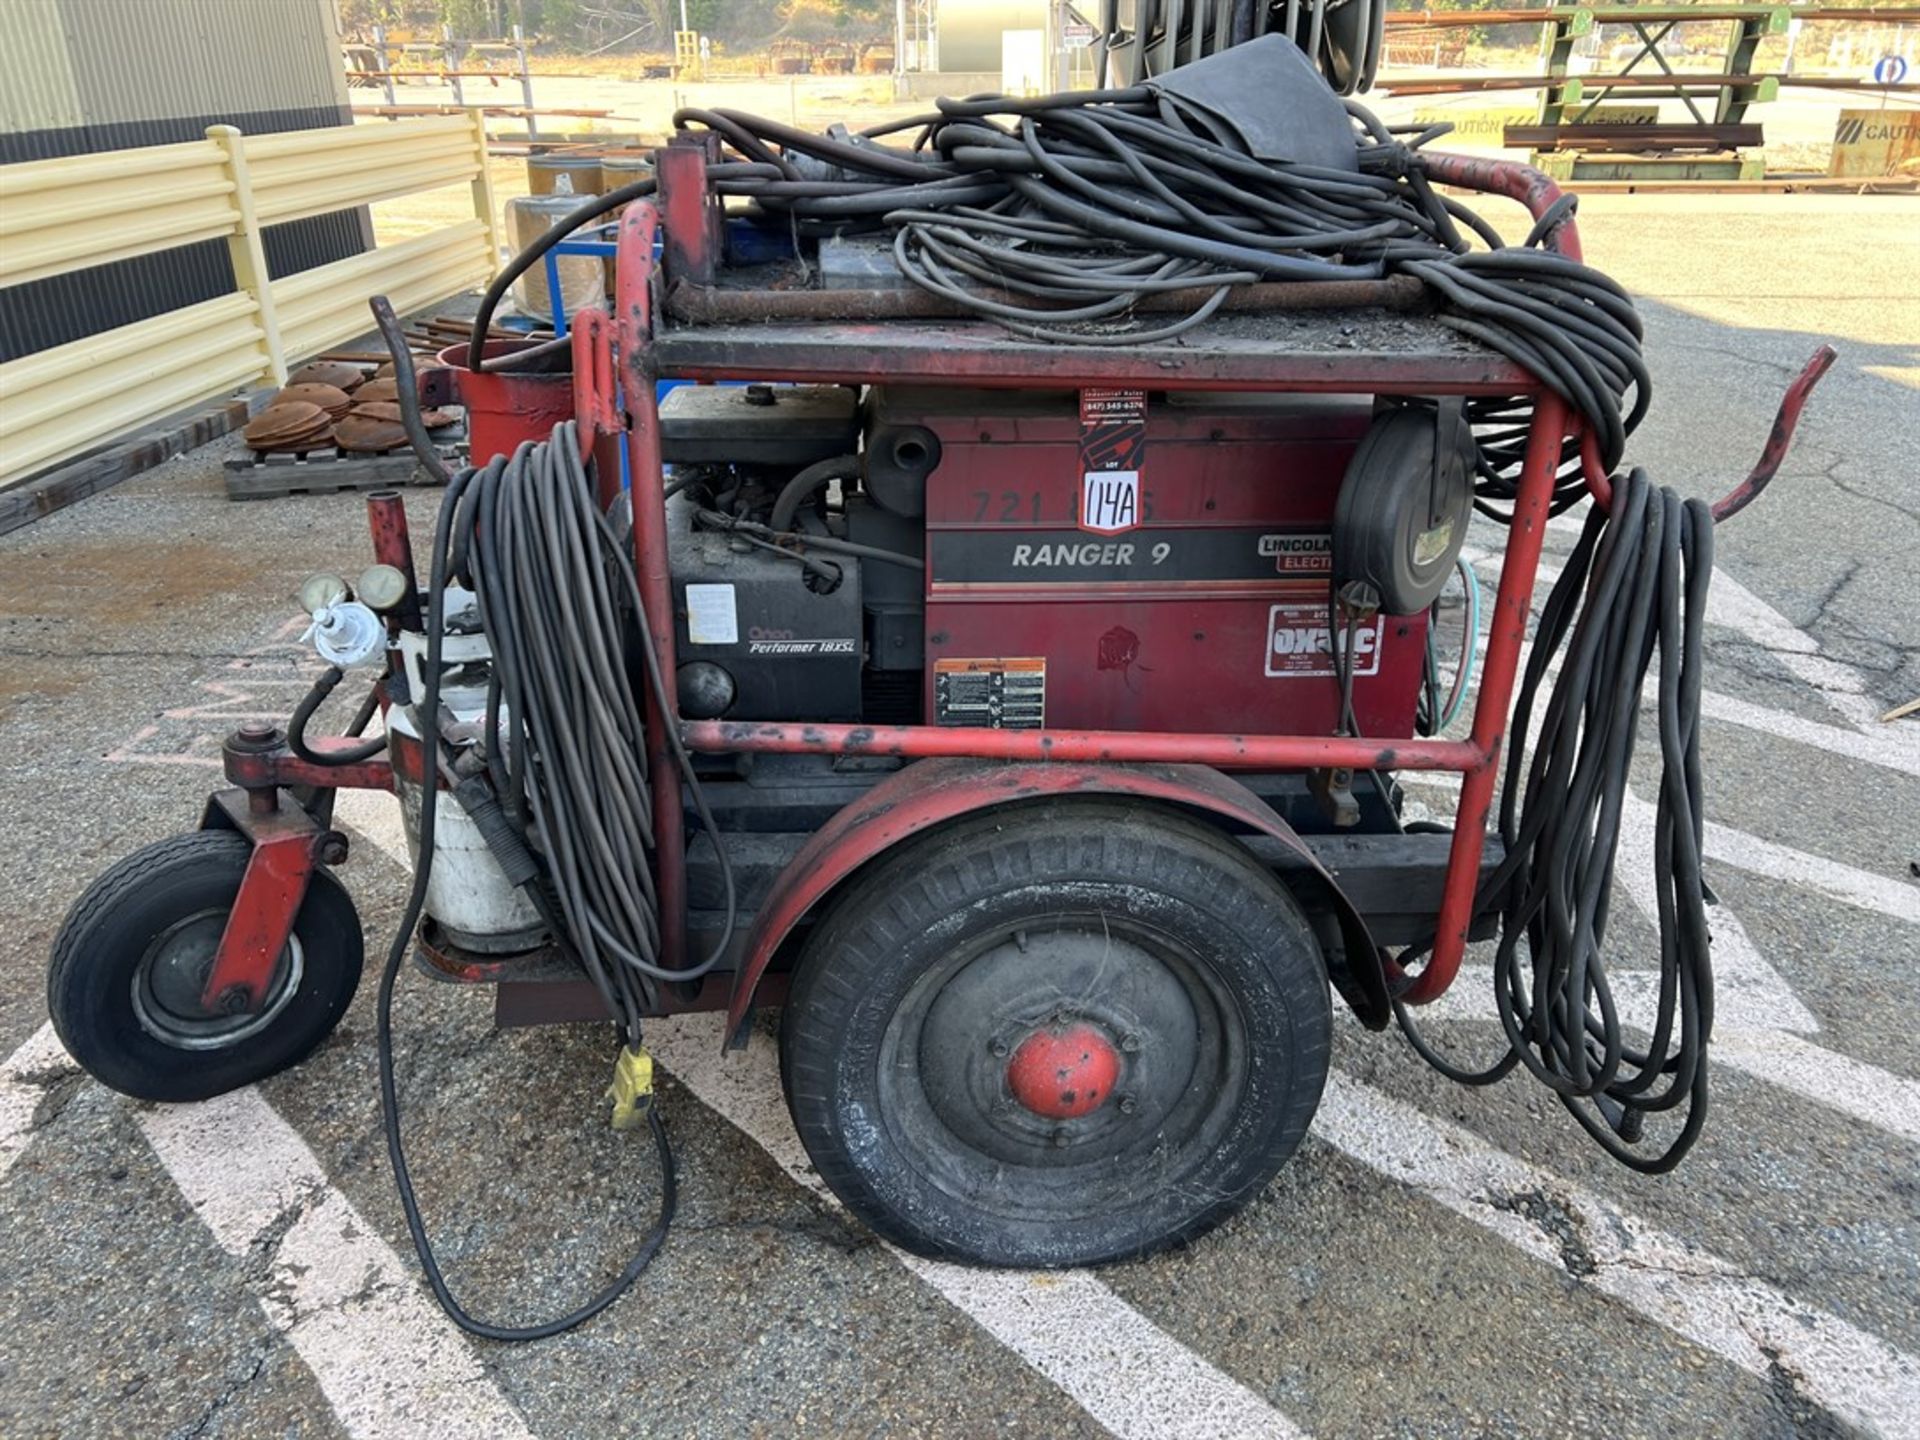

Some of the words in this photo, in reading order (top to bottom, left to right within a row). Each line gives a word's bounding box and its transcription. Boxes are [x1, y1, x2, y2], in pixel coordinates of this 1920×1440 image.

[1865, 124, 1920, 140] CAUTI
[1086, 479, 1136, 526] 114A
[1012, 544, 1136, 567] RANGER
[1151, 542, 1171, 565] 9
[1285, 556, 1332, 569] ELECT
[750, 643, 816, 653] Performer
